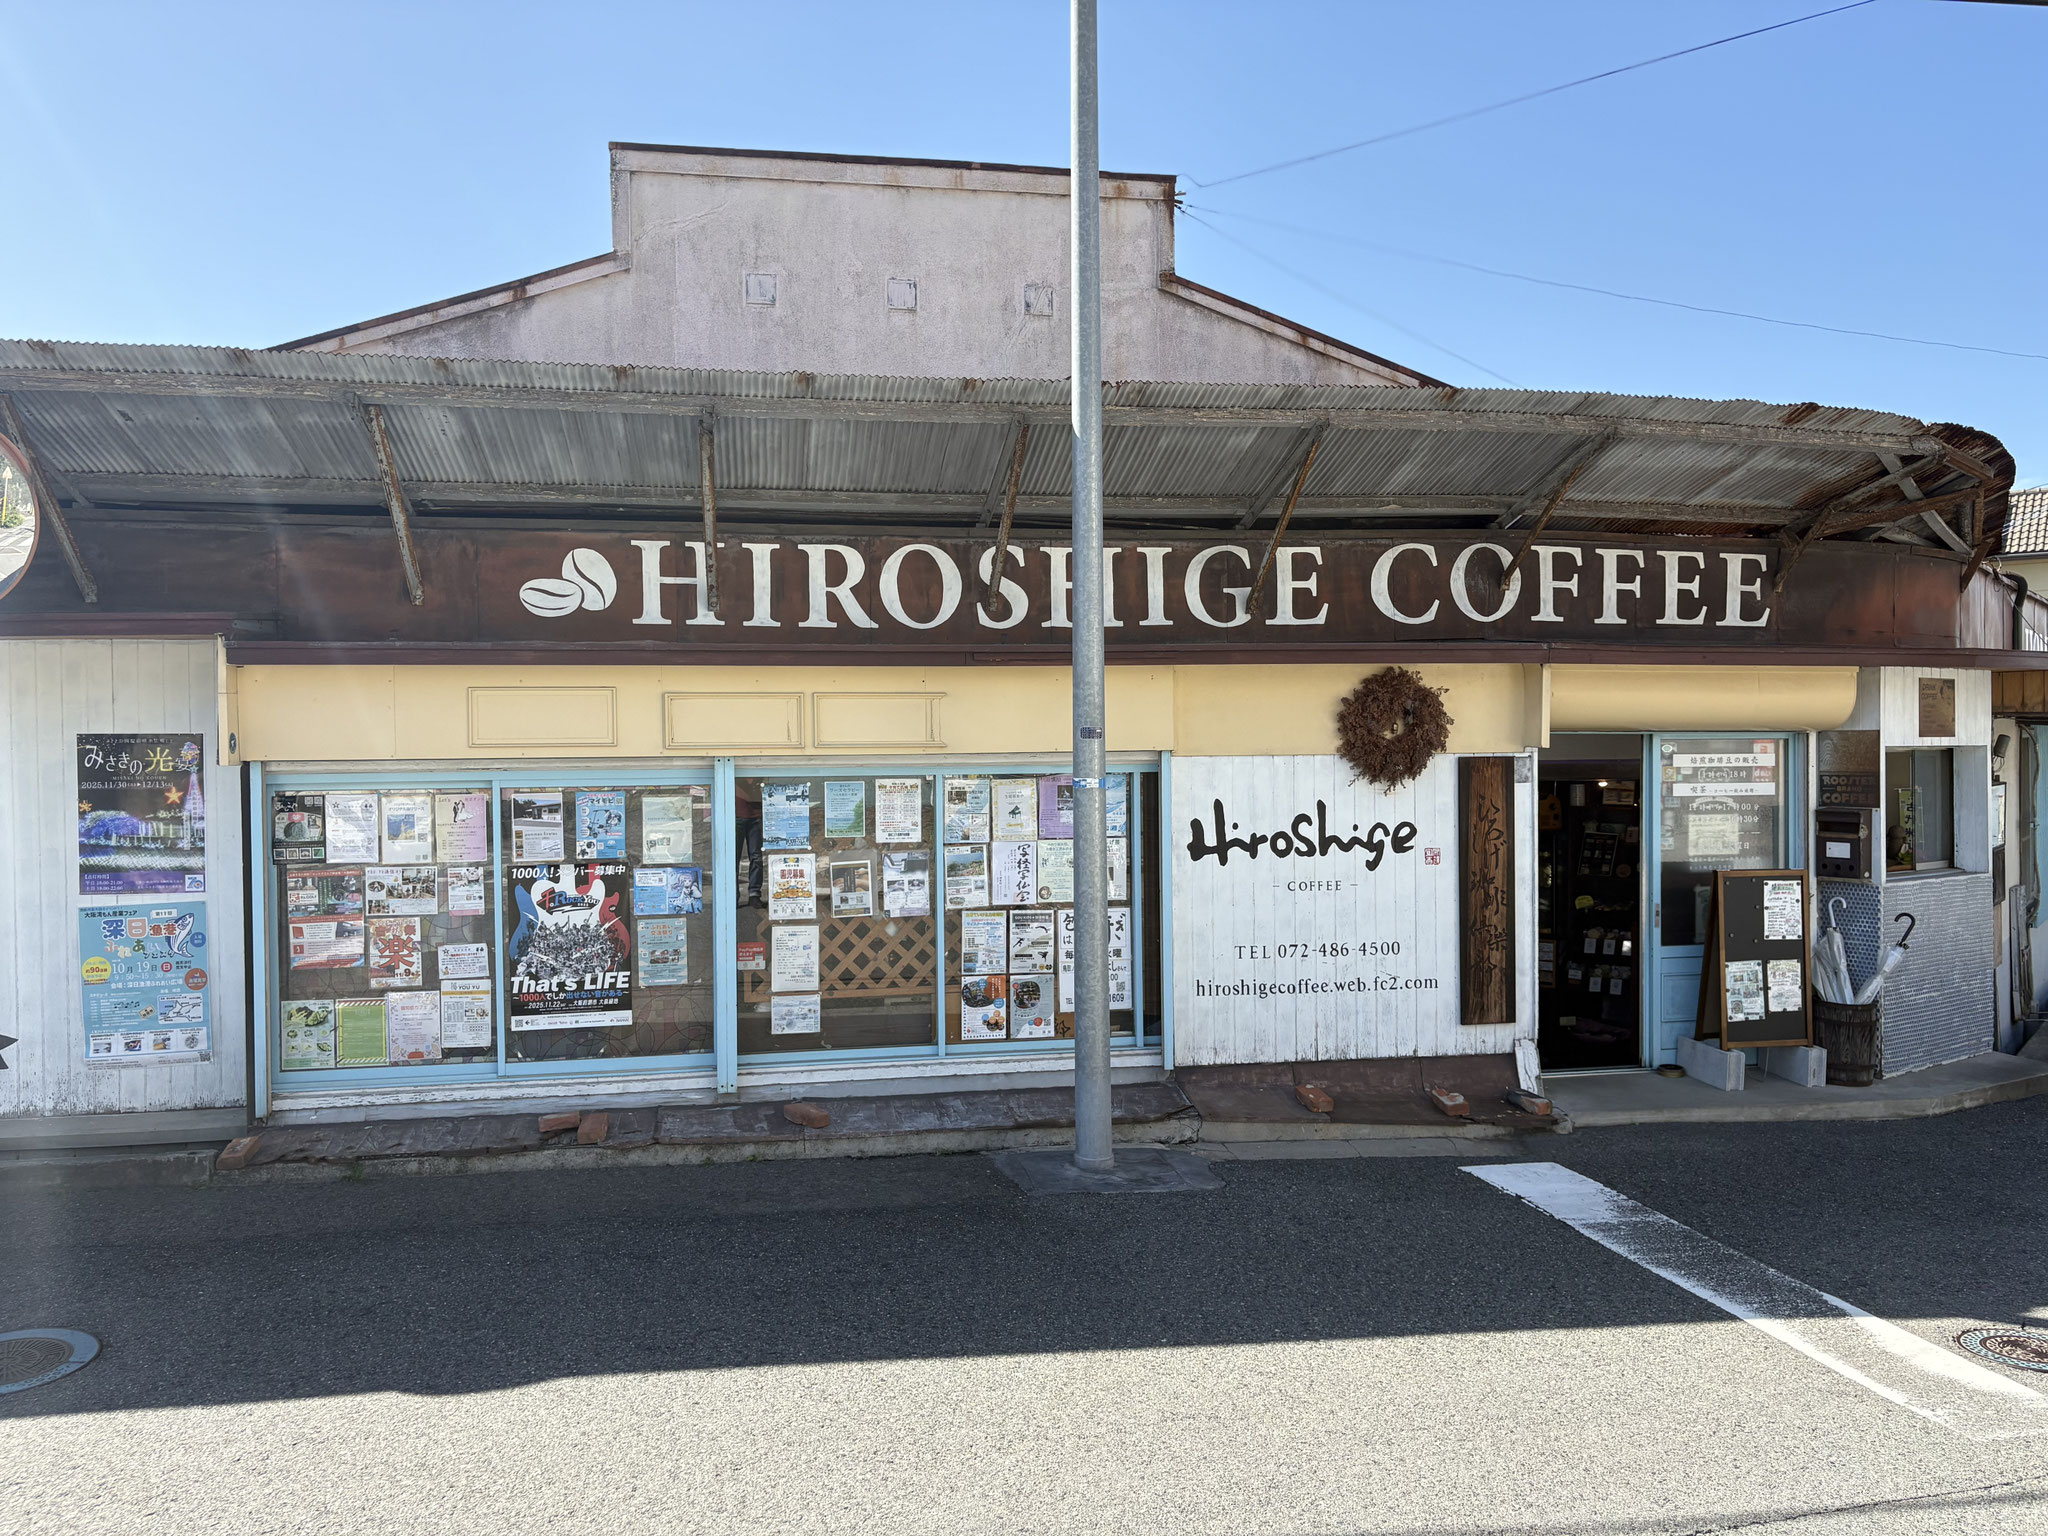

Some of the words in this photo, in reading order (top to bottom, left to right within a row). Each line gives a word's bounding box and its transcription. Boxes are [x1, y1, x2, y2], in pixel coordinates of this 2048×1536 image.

[630, 539, 1329, 630] HIROSHIGE
[1370, 542, 1772, 627] COFFEE
[1287, 880, 1342, 891] COFFEE
[1235, 945, 1271, 960] TEL
[1277, 940, 1401, 959] 072-486-4500
[511, 975, 578, 993] That's
[584, 971, 631, 990] LIFE
[1195, 976, 1439, 999] hiroshigecoffee.web.fc2.com
